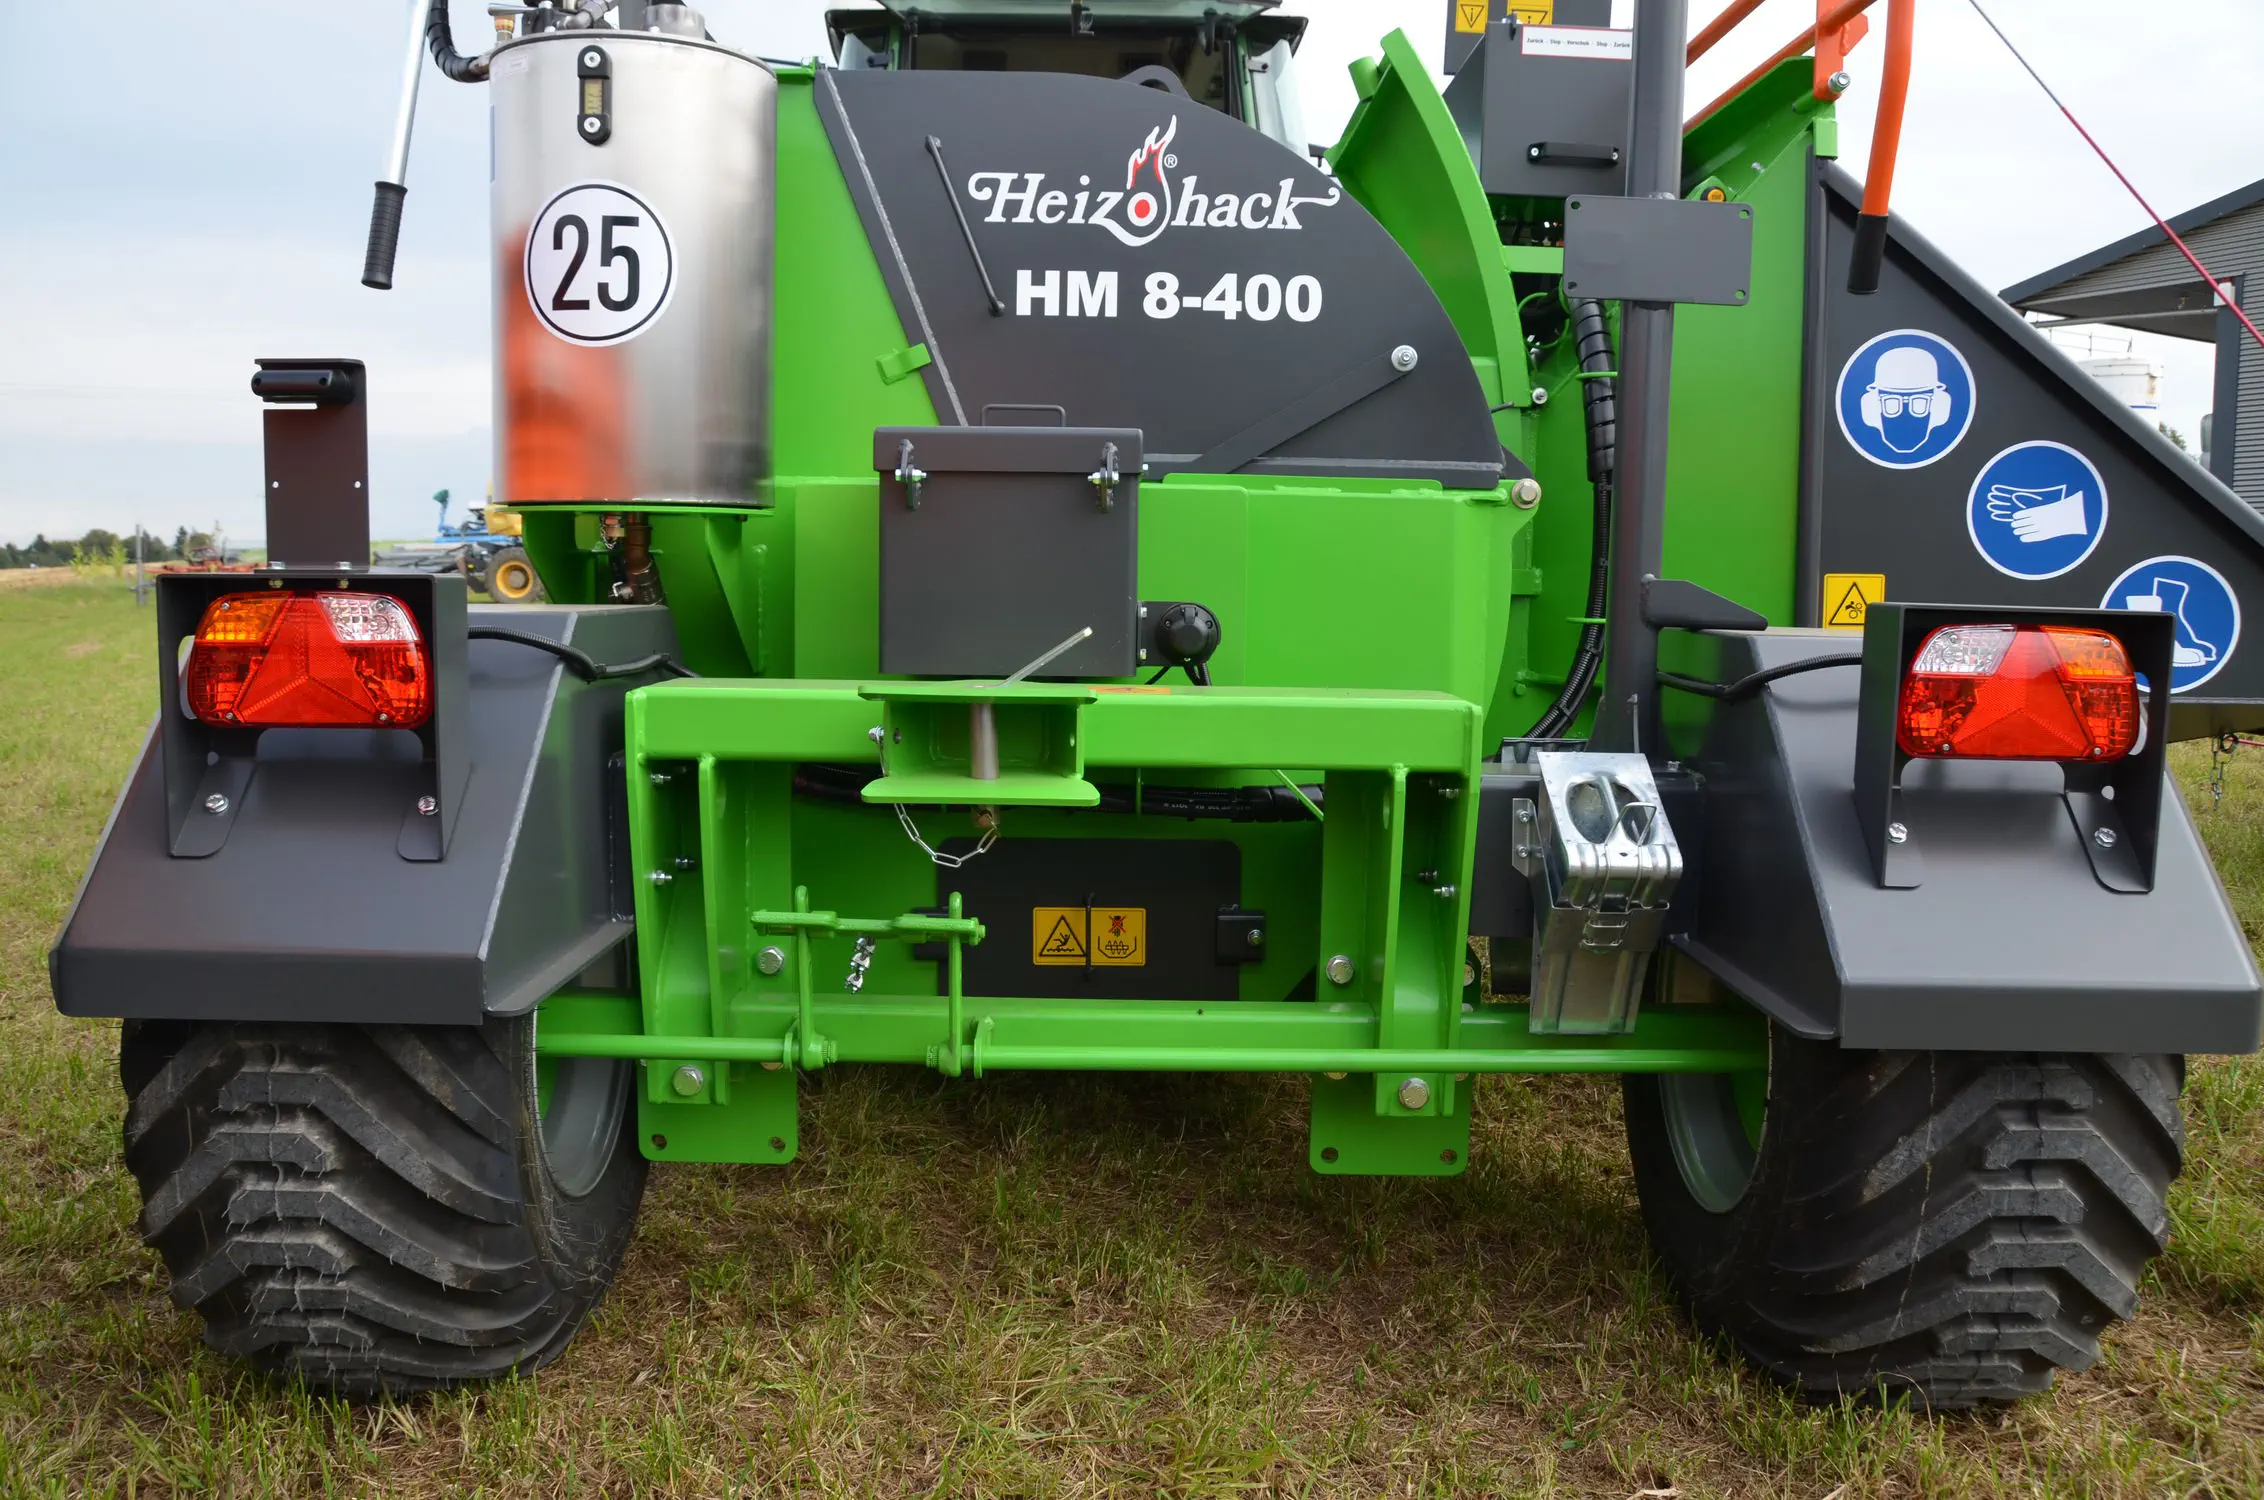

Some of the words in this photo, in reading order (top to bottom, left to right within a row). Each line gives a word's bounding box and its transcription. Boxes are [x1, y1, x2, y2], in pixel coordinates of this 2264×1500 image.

[552, 214, 640, 312] 25
[1016, 269, 1119, 318] HM
[1142, 271, 1323, 322] 8-400
